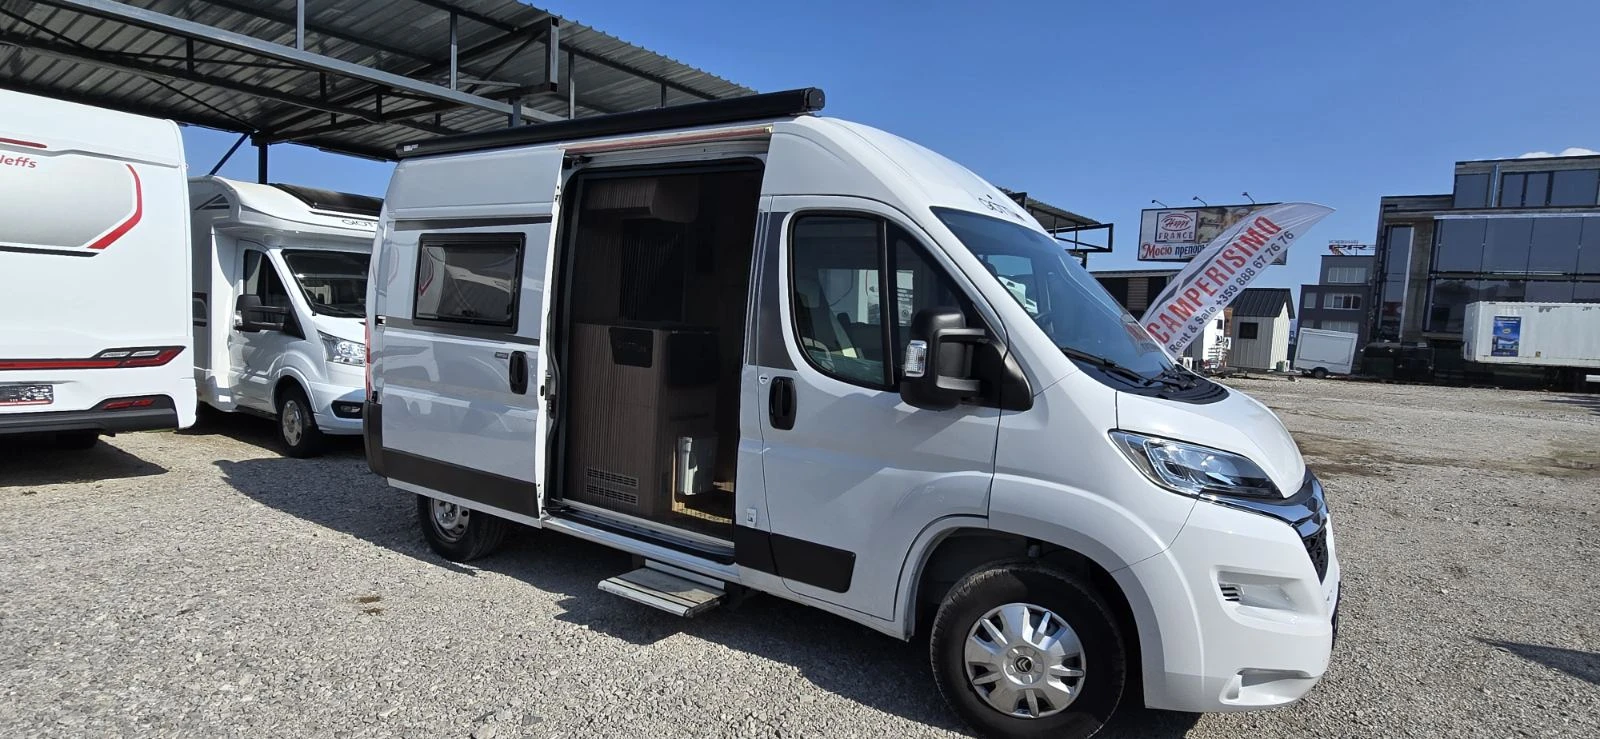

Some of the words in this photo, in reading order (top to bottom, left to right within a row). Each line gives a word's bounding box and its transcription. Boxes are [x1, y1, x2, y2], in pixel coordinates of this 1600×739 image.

[1146, 216, 1281, 344] CAMPERISIMO
[1158, 232, 1193, 240] FRANCE
[1168, 332, 1191, 353] Rent
[1188, 324, 1198, 333] &
[1195, 306, 1217, 324] Sale
[1216, 285, 1238, 306] +359
[1236, 267, 1256, 286] 888
[1253, 255, 1268, 268] 67
[1265, 243, 1280, 256] 76
[1277, 231, 1294, 244] 76
